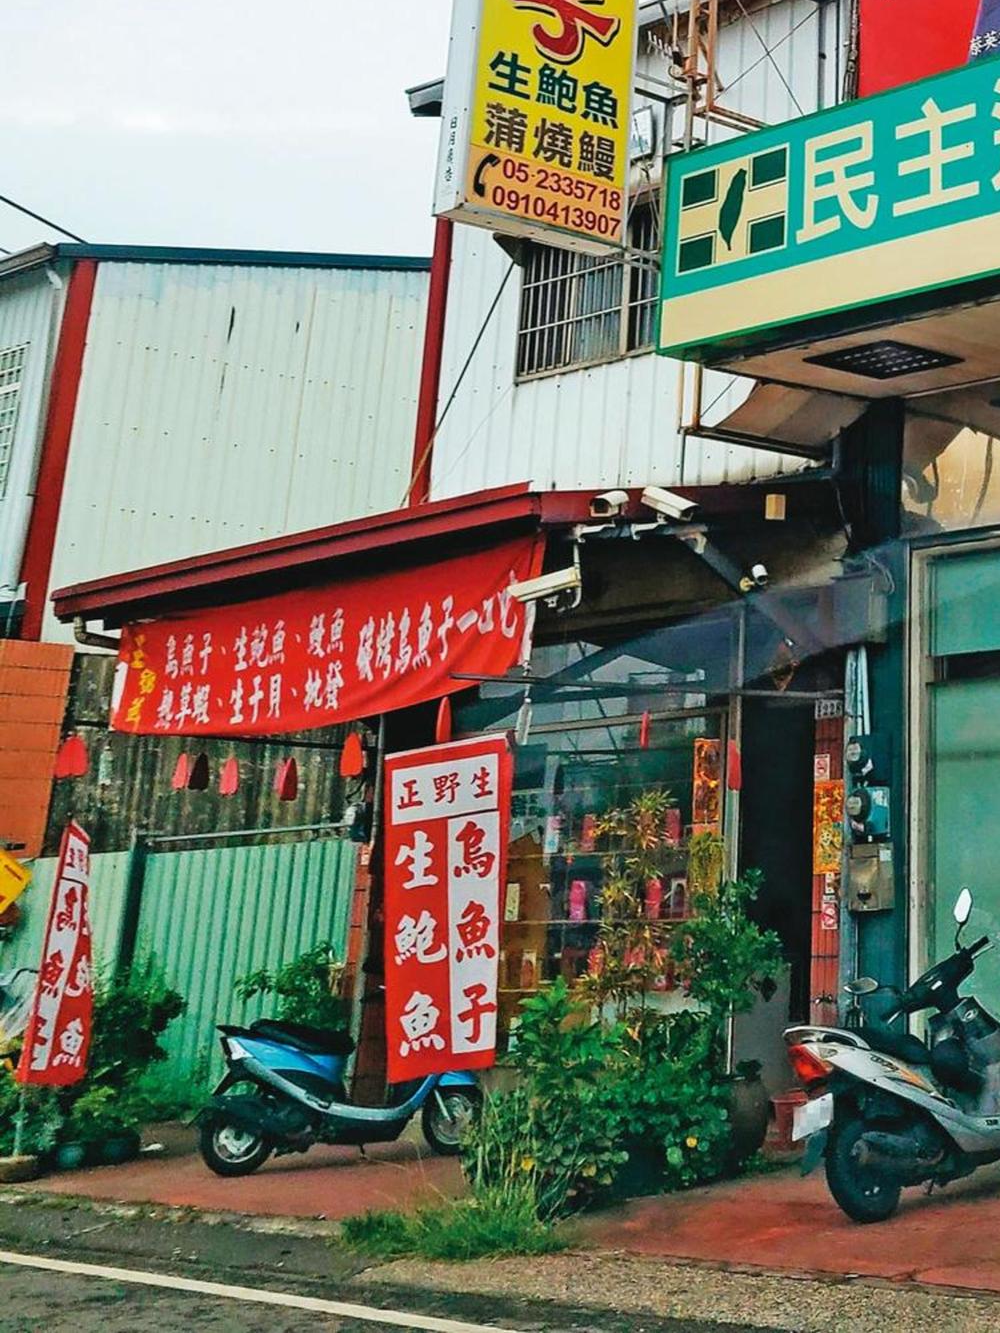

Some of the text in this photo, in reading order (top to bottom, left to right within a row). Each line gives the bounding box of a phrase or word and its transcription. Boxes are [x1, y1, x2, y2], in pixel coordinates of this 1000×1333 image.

[488, 50, 619, 130] 生鮑魚
[483, 102, 615, 183] 蒲燒鰻
[492, 185, 622, 238] 0910413907
[396, 766, 495, 811] 正野生
[394, 829, 447, 1058] 生鮑魚
[454, 820, 497, 1045] 烏魚子
